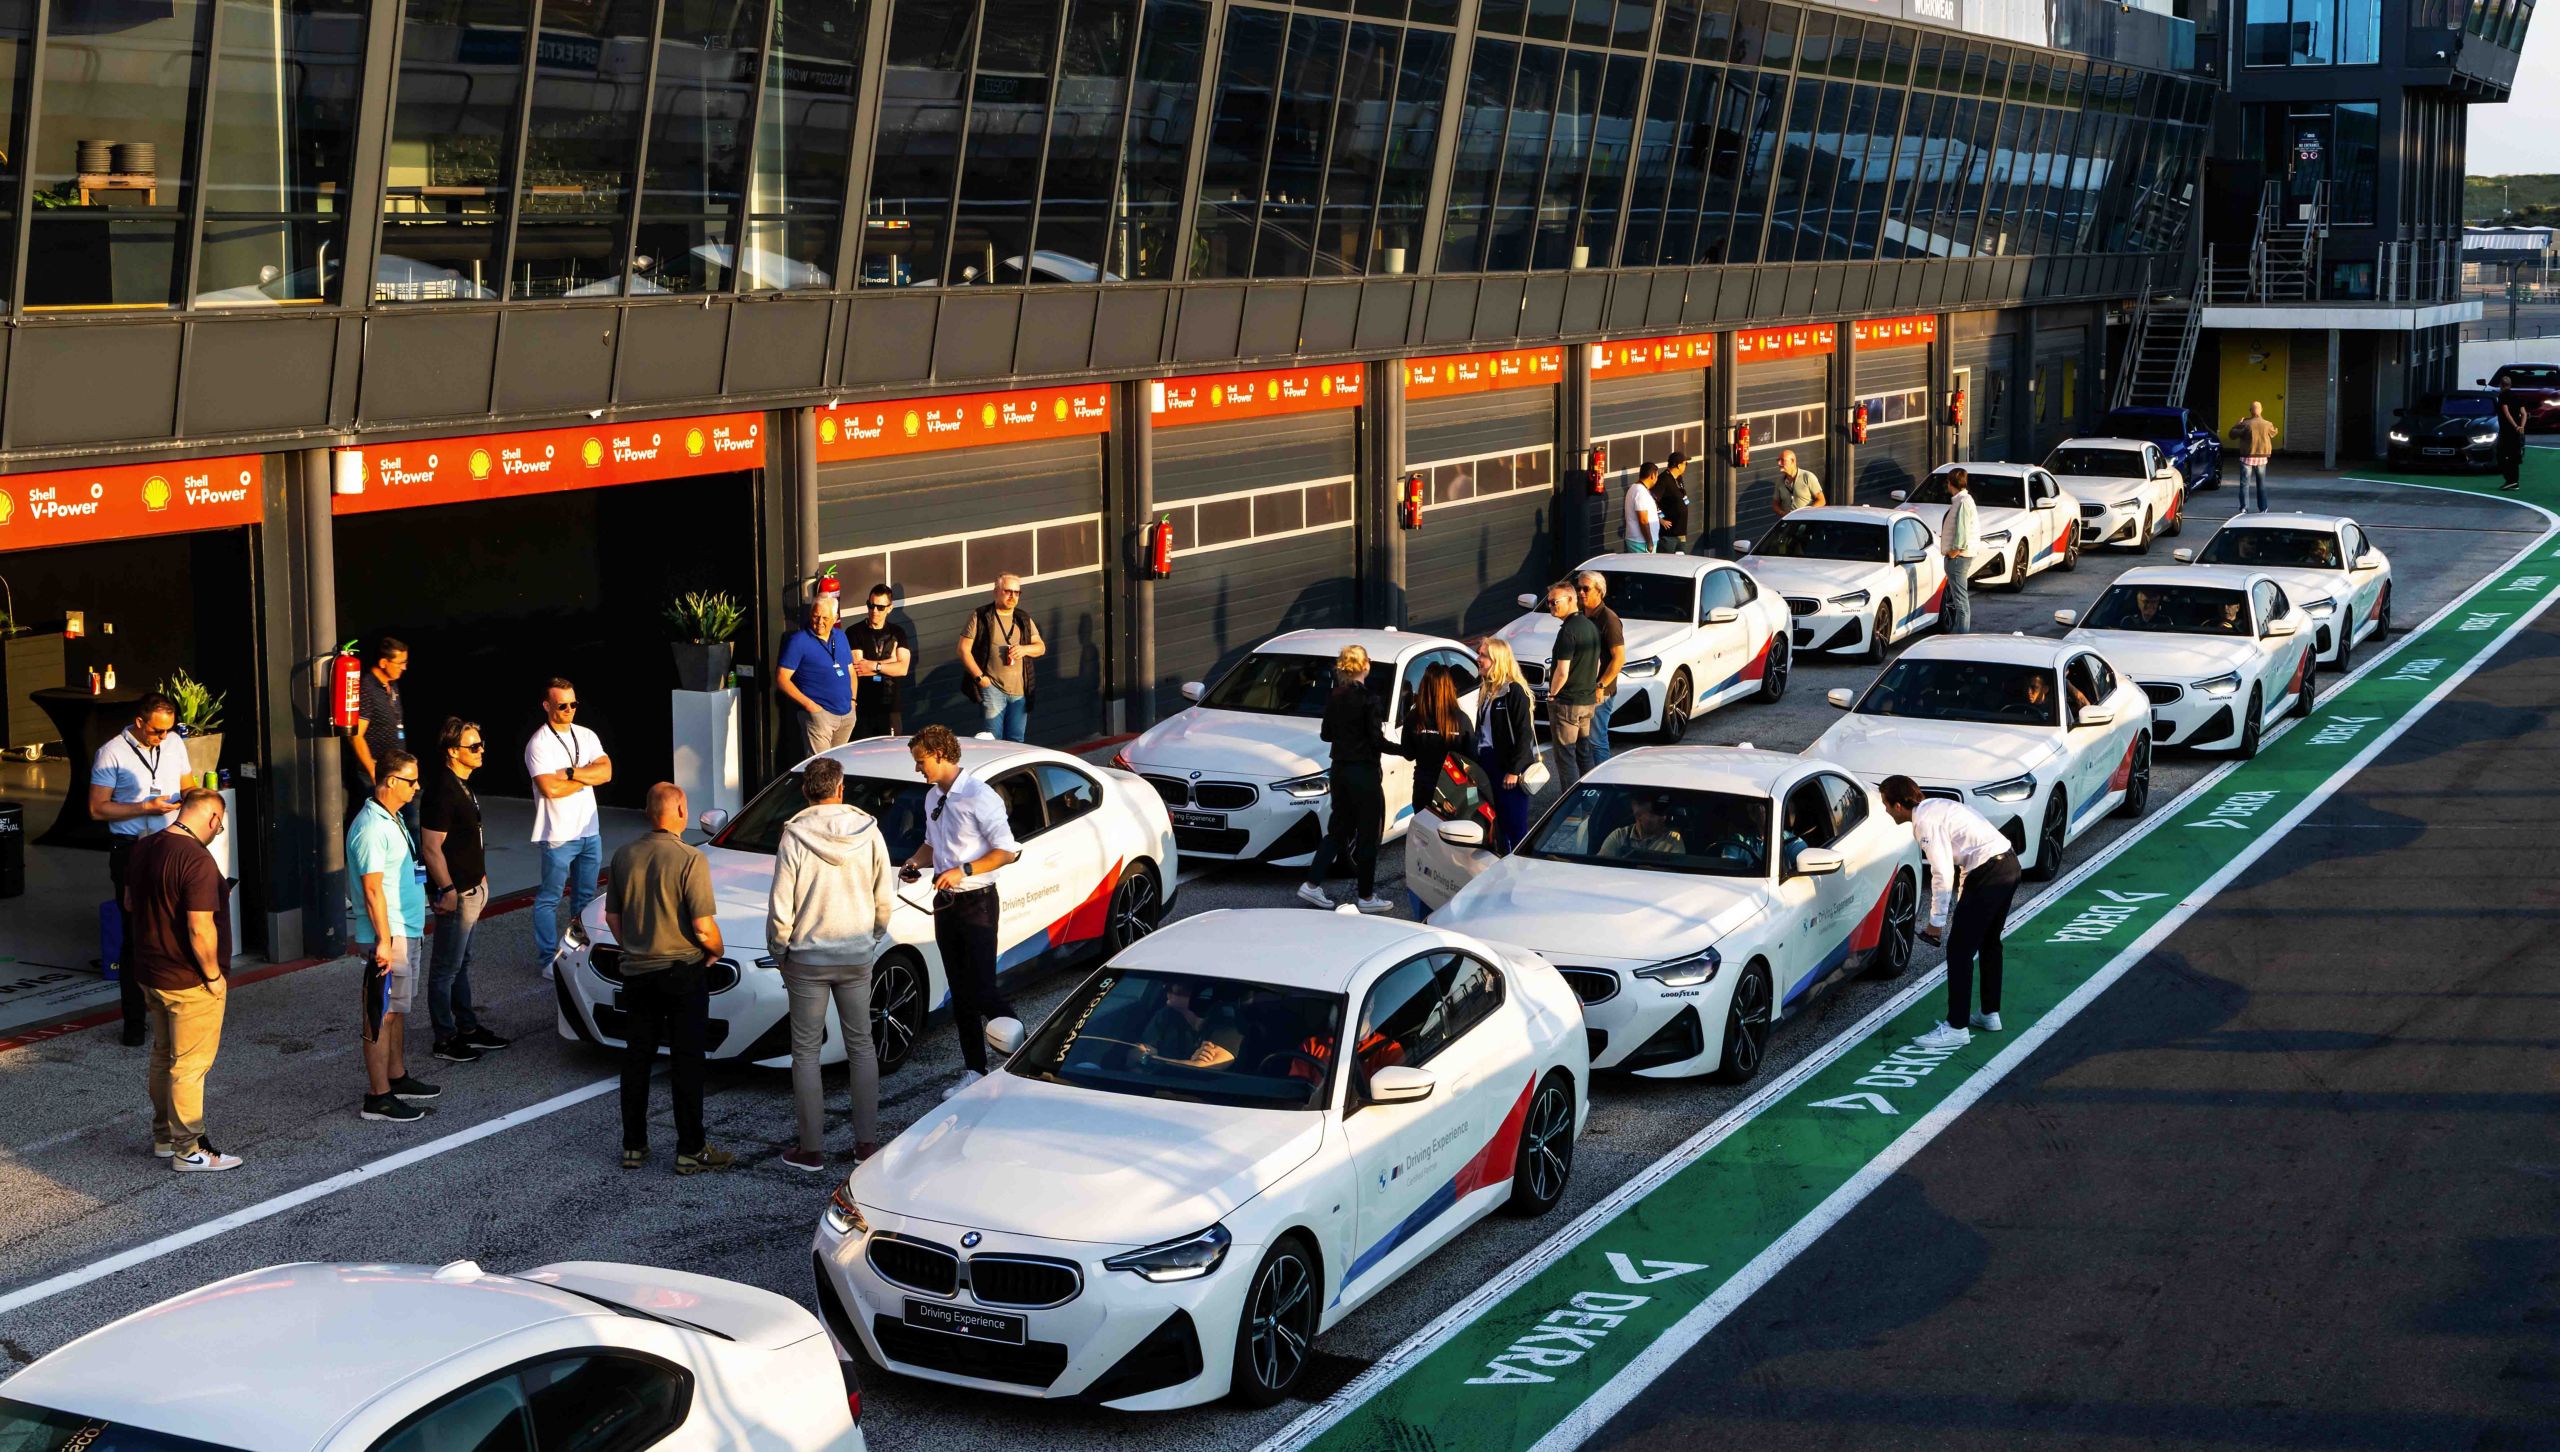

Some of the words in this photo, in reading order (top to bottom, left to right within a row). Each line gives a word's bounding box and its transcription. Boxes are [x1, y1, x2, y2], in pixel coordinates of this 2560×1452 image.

[1914, 0, 1954, 21] WORKWEAR
[1283, 387, 1307, 397] V-Power
[1335, 383, 1358, 393] V-Power
[1167, 398, 1195, 409] V-Power
[1227, 392, 1253, 404] V-Power
[926, 410, 941, 421] Shell
[1003, 412, 1035, 425] V-Power
[1074, 406, 1104, 418] V-Power
[844, 416, 859, 428] Shell
[927, 420, 961, 433] V-Power
[713, 427, 730, 439] Shell
[844, 427, 881, 440] V-Power
[612, 436, 631, 449] Shell
[713, 438, 755, 452] V-Power
[501, 447, 521, 461] Shell
[613, 447, 658, 463] V-Power
[380, 457, 402, 471] Shell
[502, 459, 552, 475] V-Power
[184, 474, 209, 489] Shell
[381, 469, 435, 486] V-Power
[29, 486, 56, 502] Shell
[185, 488, 247, 506] V-Power
[29, 501, 99, 520] V-Power
[2305, 724, 2366, 744] DEKRA
[2207, 790, 2280, 817] DEKRA
[1185, 814, 1216, 823] Experience
[1433, 870, 1449, 890] Driving
[1002, 895, 1025, 912] Driving
[1026, 882, 1060, 903] Experience
[2045, 905, 2139, 943] DEKRA
[1660, 990, 1700, 998] GOODYEAR
[1853, 1042, 1966, 1088] DEKR
[1406, 1145, 1432, 1169] Driving
[1432, 1120, 1469, 1154] Experience
[920, 1305, 952, 1322] Driving
[953, 1311, 1006, 1330] Experience
[1463, 1291, 1651, 1385] DEKRA
